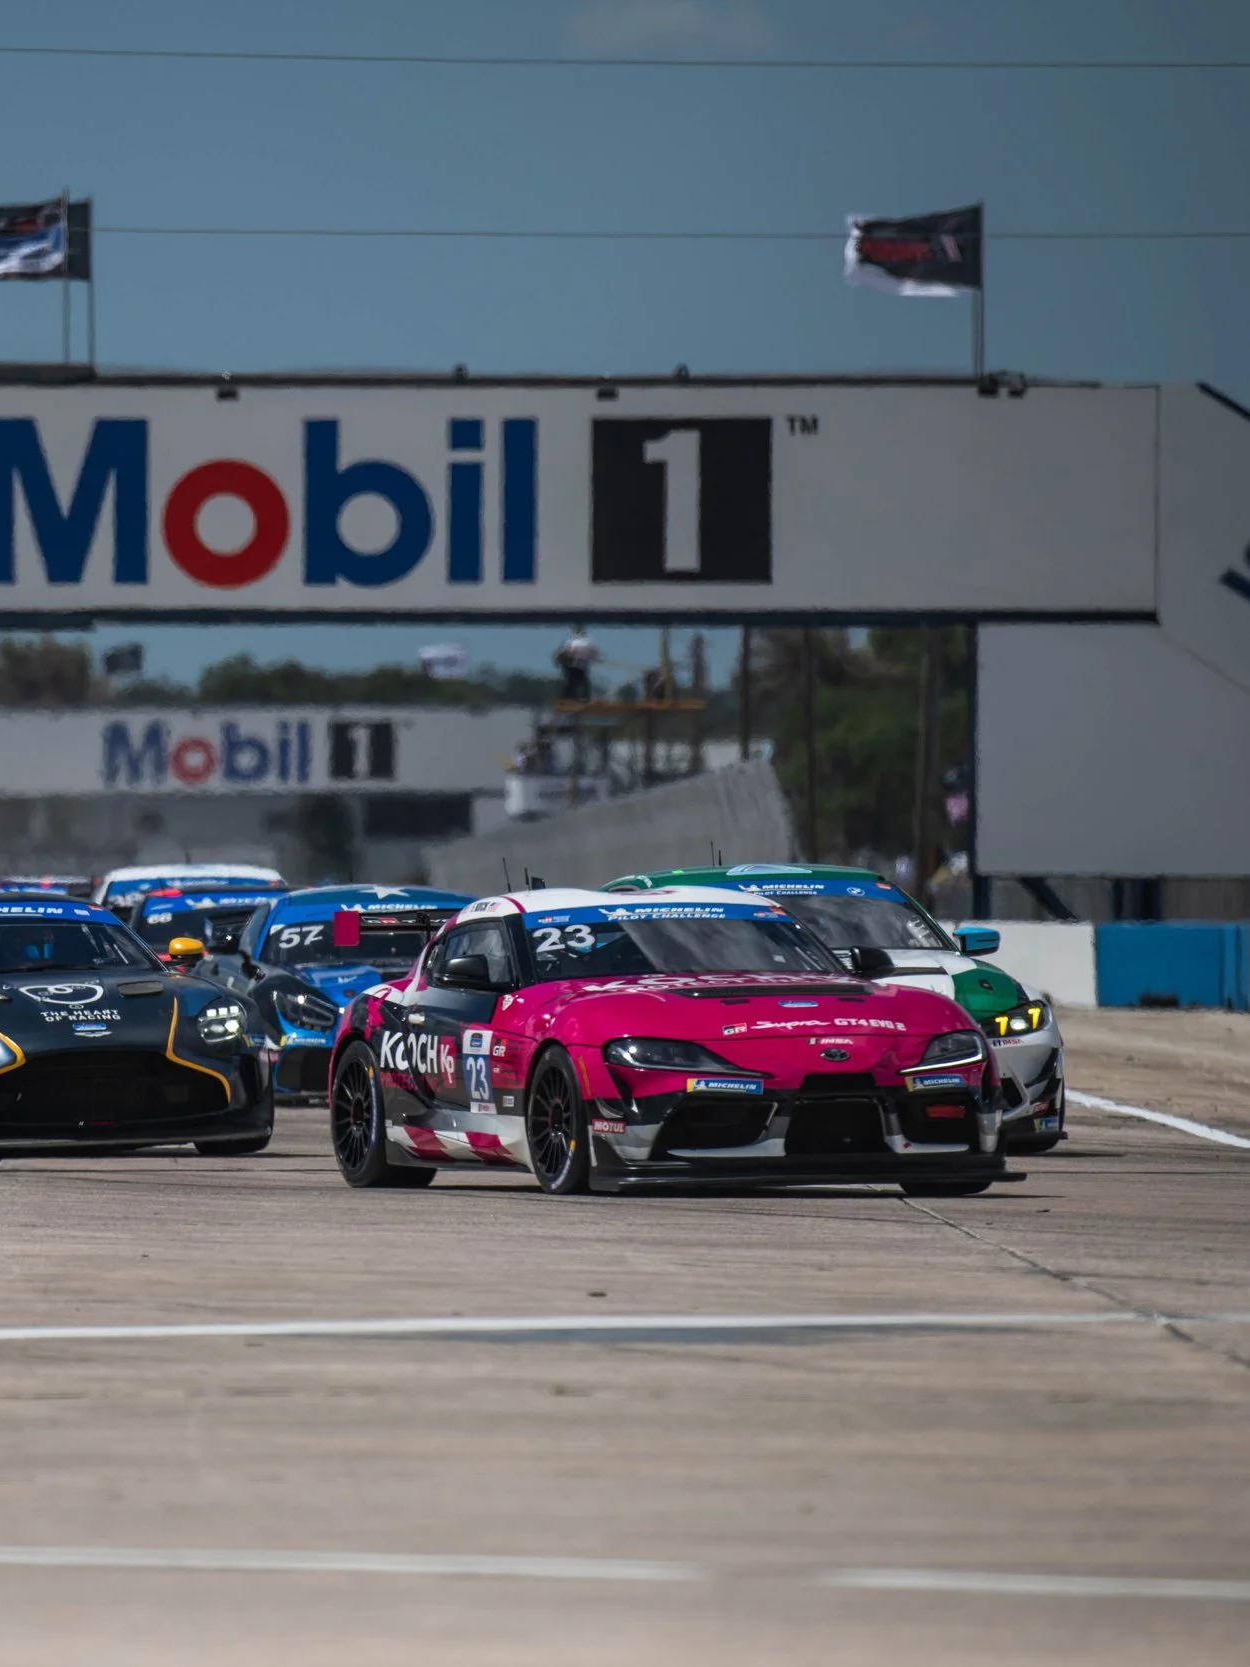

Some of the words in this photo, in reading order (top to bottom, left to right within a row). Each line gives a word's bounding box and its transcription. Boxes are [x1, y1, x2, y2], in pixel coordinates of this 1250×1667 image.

[101, 719, 312, 786] Mobil
[607, 913, 646, 921] PILOT
[651, 912, 726, 920] CHALLENGE
[278, 924, 325, 950] 57
[531, 923, 596, 953] 23
[39, 1010, 69, 1018] THE
[722, 1025, 748, 1036] GR
[750, 1020, 831, 1030] Supra
[492, 1045, 506, 1058] GR
[466, 1056, 490, 1100] 23
[922, 1077, 960, 1086] MICHELIN
[708, 1081, 757, 1091] MICHELIN
[594, 1120, 625, 1133] MOTUL
